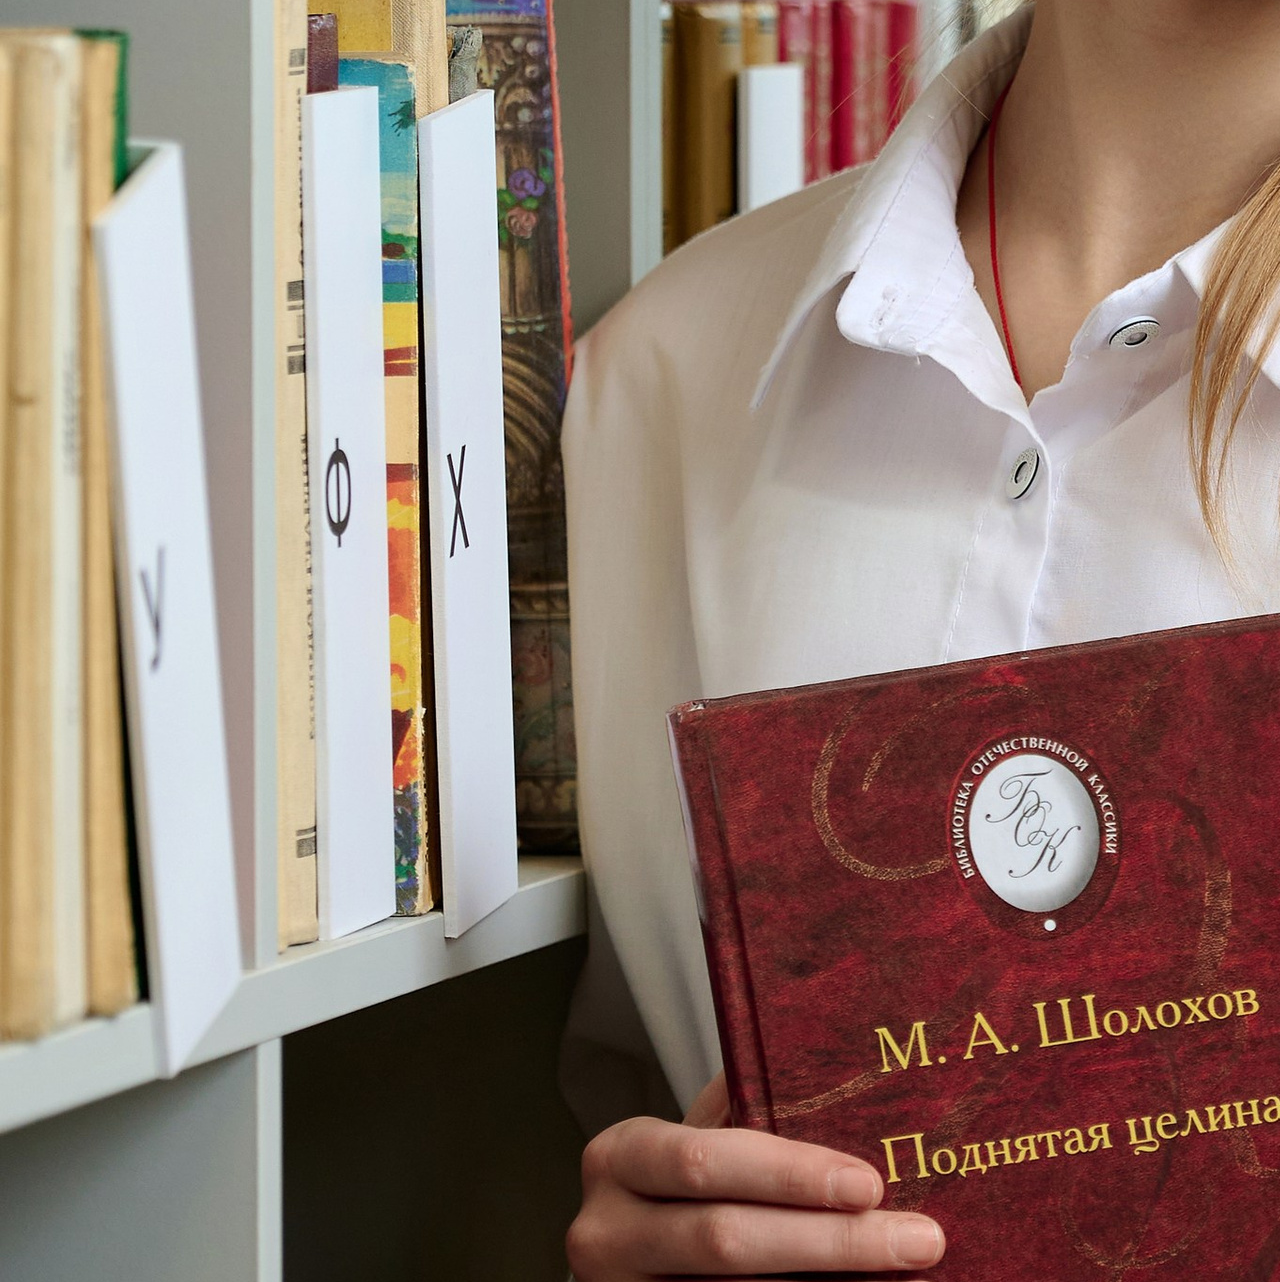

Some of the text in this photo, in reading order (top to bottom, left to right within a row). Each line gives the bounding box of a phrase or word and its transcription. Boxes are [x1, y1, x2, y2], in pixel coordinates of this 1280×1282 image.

[326, 437, 352, 548] Ф
[446, 443, 469, 559] Х
[139, 544, 165, 674] У
[953, 737, 1118, 879] БИБЛИОТЕКА ОТЕЧЕСТВЕННОЙ КЛАССИКИ
[874, 988, 1260, 1073] М. А. Шолохов
[881, 1123, 1113, 1184] Поднятая
